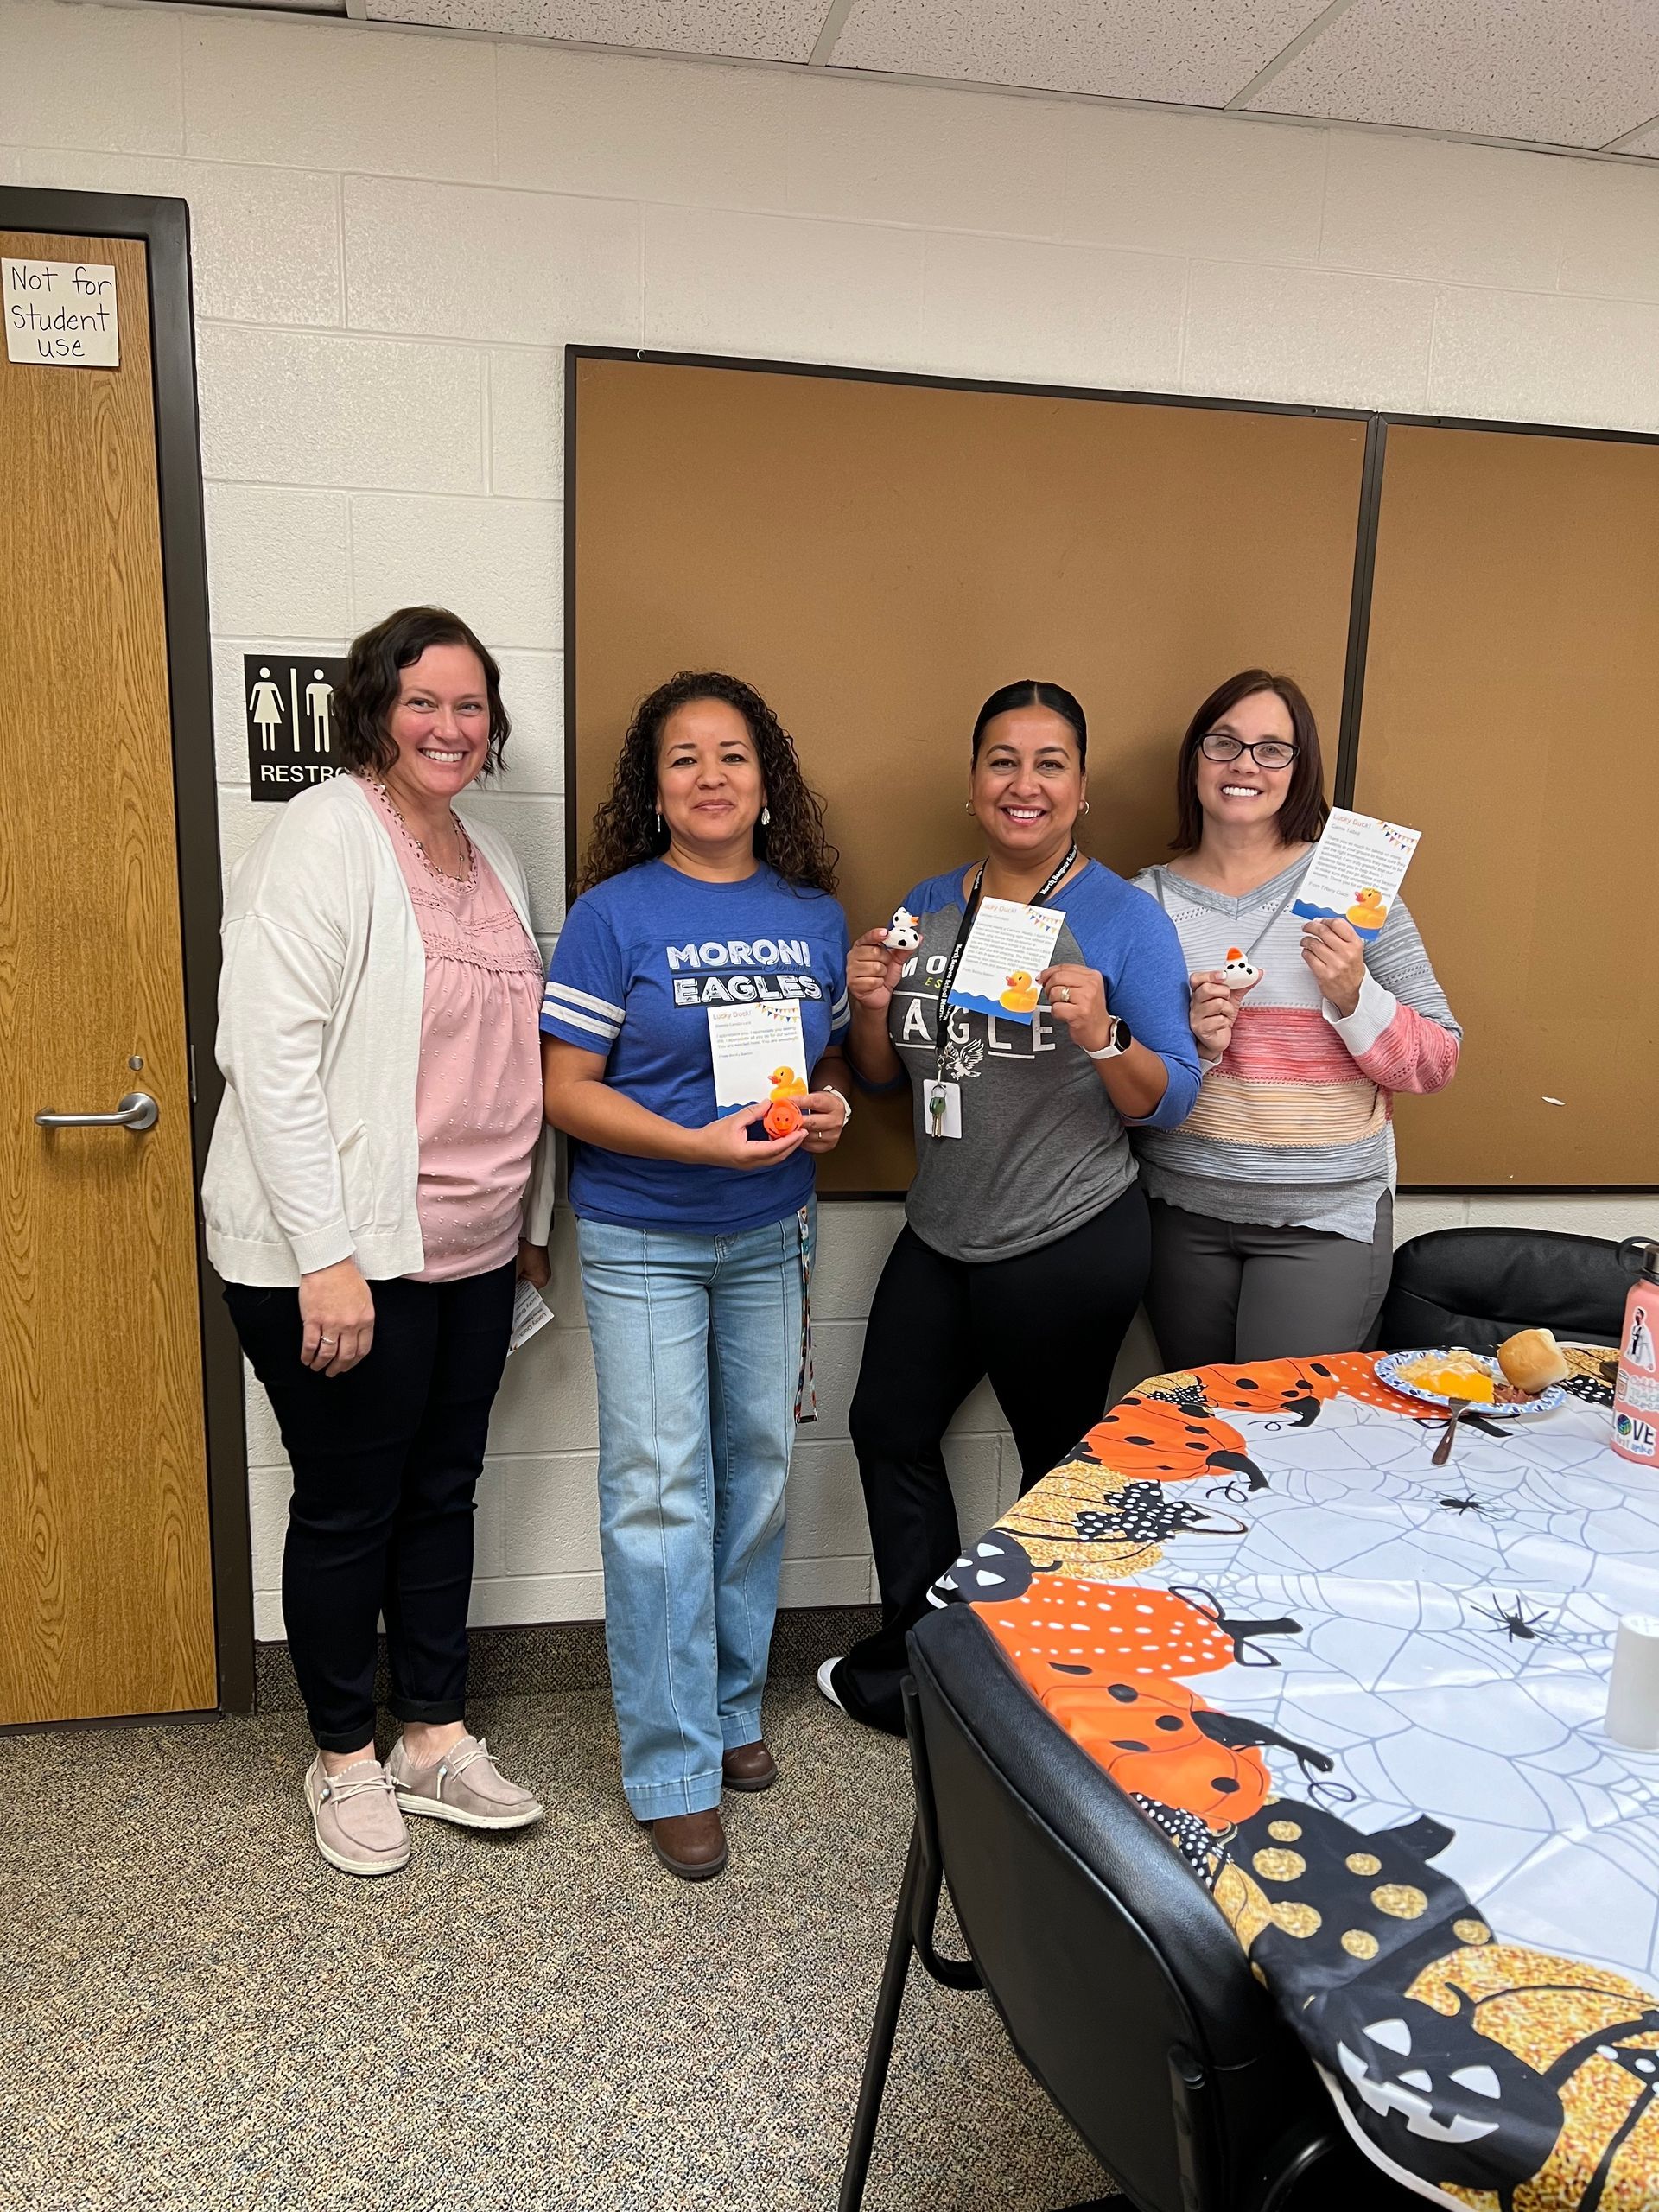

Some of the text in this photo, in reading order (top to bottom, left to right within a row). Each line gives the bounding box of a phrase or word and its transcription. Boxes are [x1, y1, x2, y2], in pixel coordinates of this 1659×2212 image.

[11, 265, 112, 296] Not for
[11, 302, 111, 331] Student
[37, 338, 85, 358] use
[1333, 814, 1351, 823] Lucky
[1039, 880, 1056, 895] North
[666, 939, 810, 969] MORONI
[673, 975, 823, 1005] EAGLES
[532, 1313, 547, 1326] Lucky
